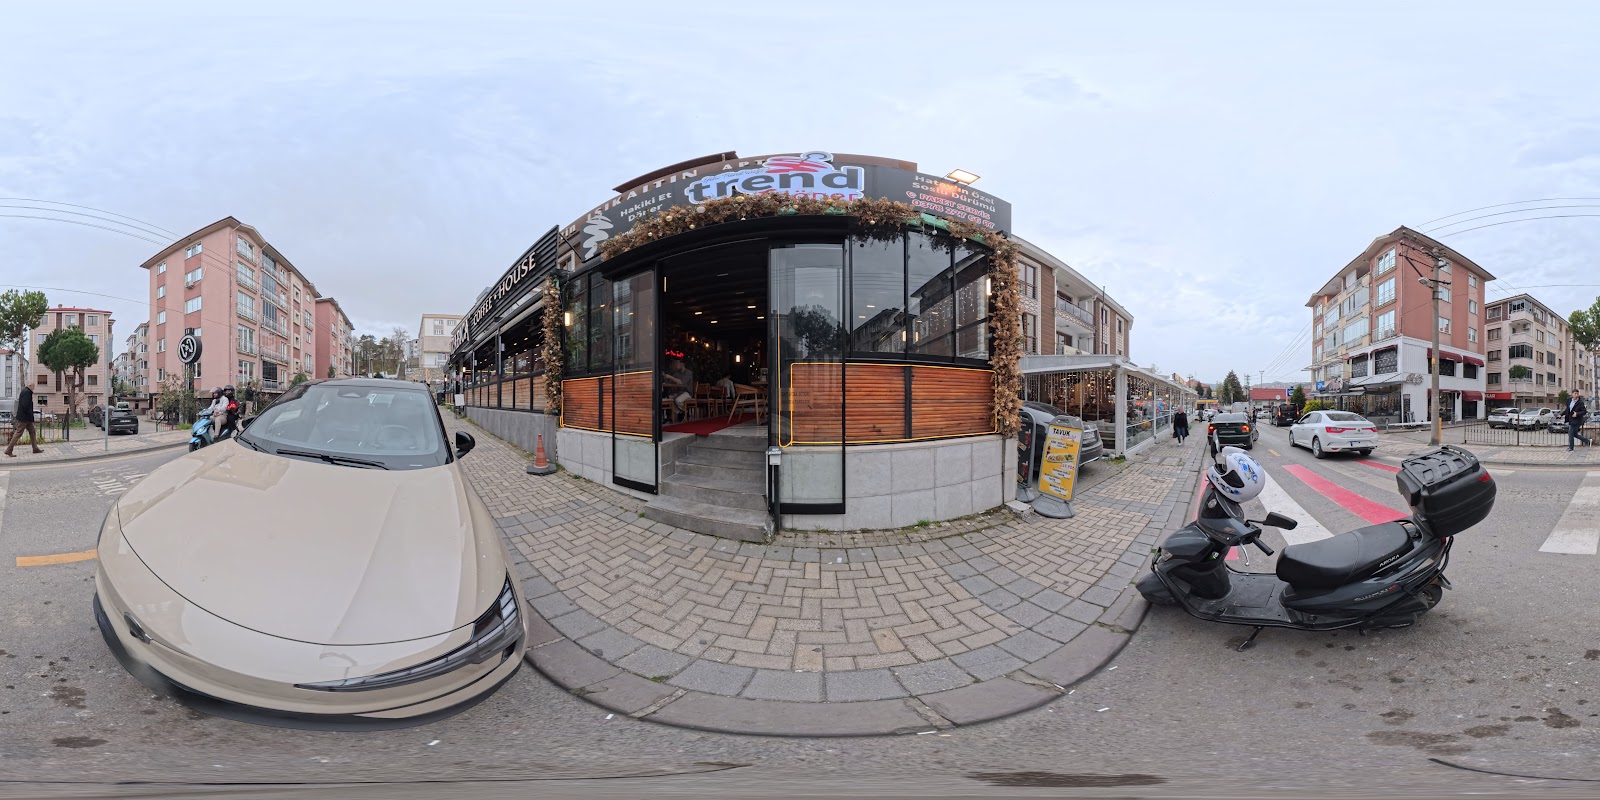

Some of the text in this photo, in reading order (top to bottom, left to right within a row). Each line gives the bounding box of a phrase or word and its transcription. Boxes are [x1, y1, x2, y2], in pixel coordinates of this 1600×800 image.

[688, 168, 859, 201] trend
[971, 188, 995, 205] Özel
[620, 192, 672, 217] Hakiki Et
[912, 182, 996, 213] Soslu Dürümü
[919, 193, 956, 207] PAKET
[473, 252, 537, 325] COFFEE HOUSE
[1053, 428, 1071, 437] TAVUK
